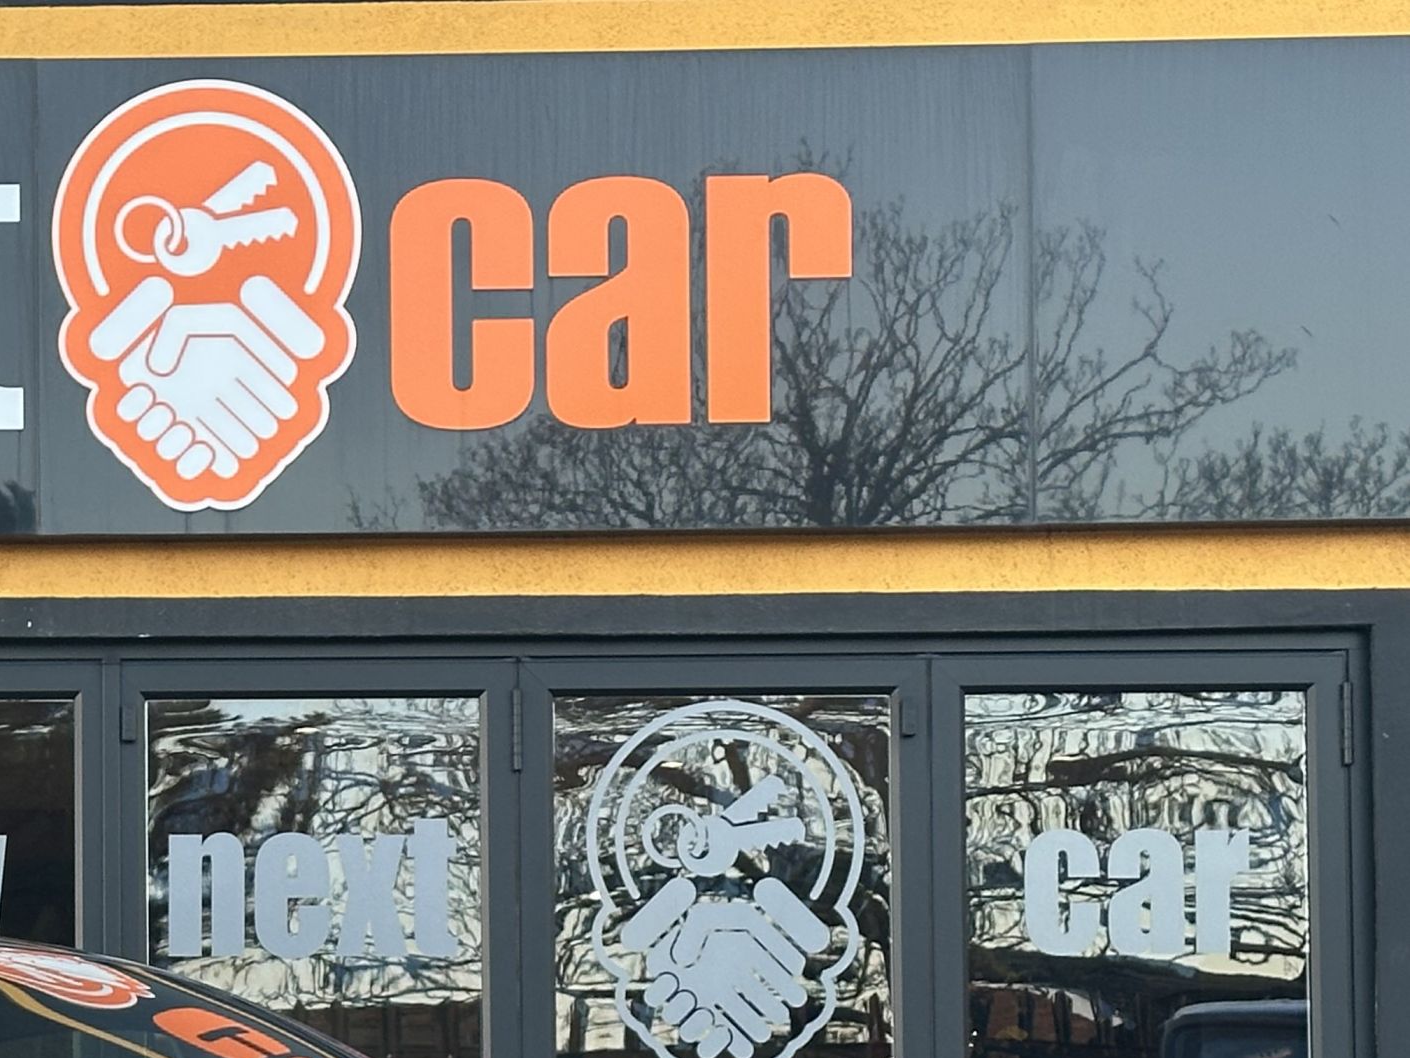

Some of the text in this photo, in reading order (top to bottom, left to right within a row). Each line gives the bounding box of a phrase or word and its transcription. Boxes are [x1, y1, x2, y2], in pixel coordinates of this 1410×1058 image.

[390, 172, 853, 431] car
[168, 818, 457, 959] next
[1024, 827, 1250, 957] car
